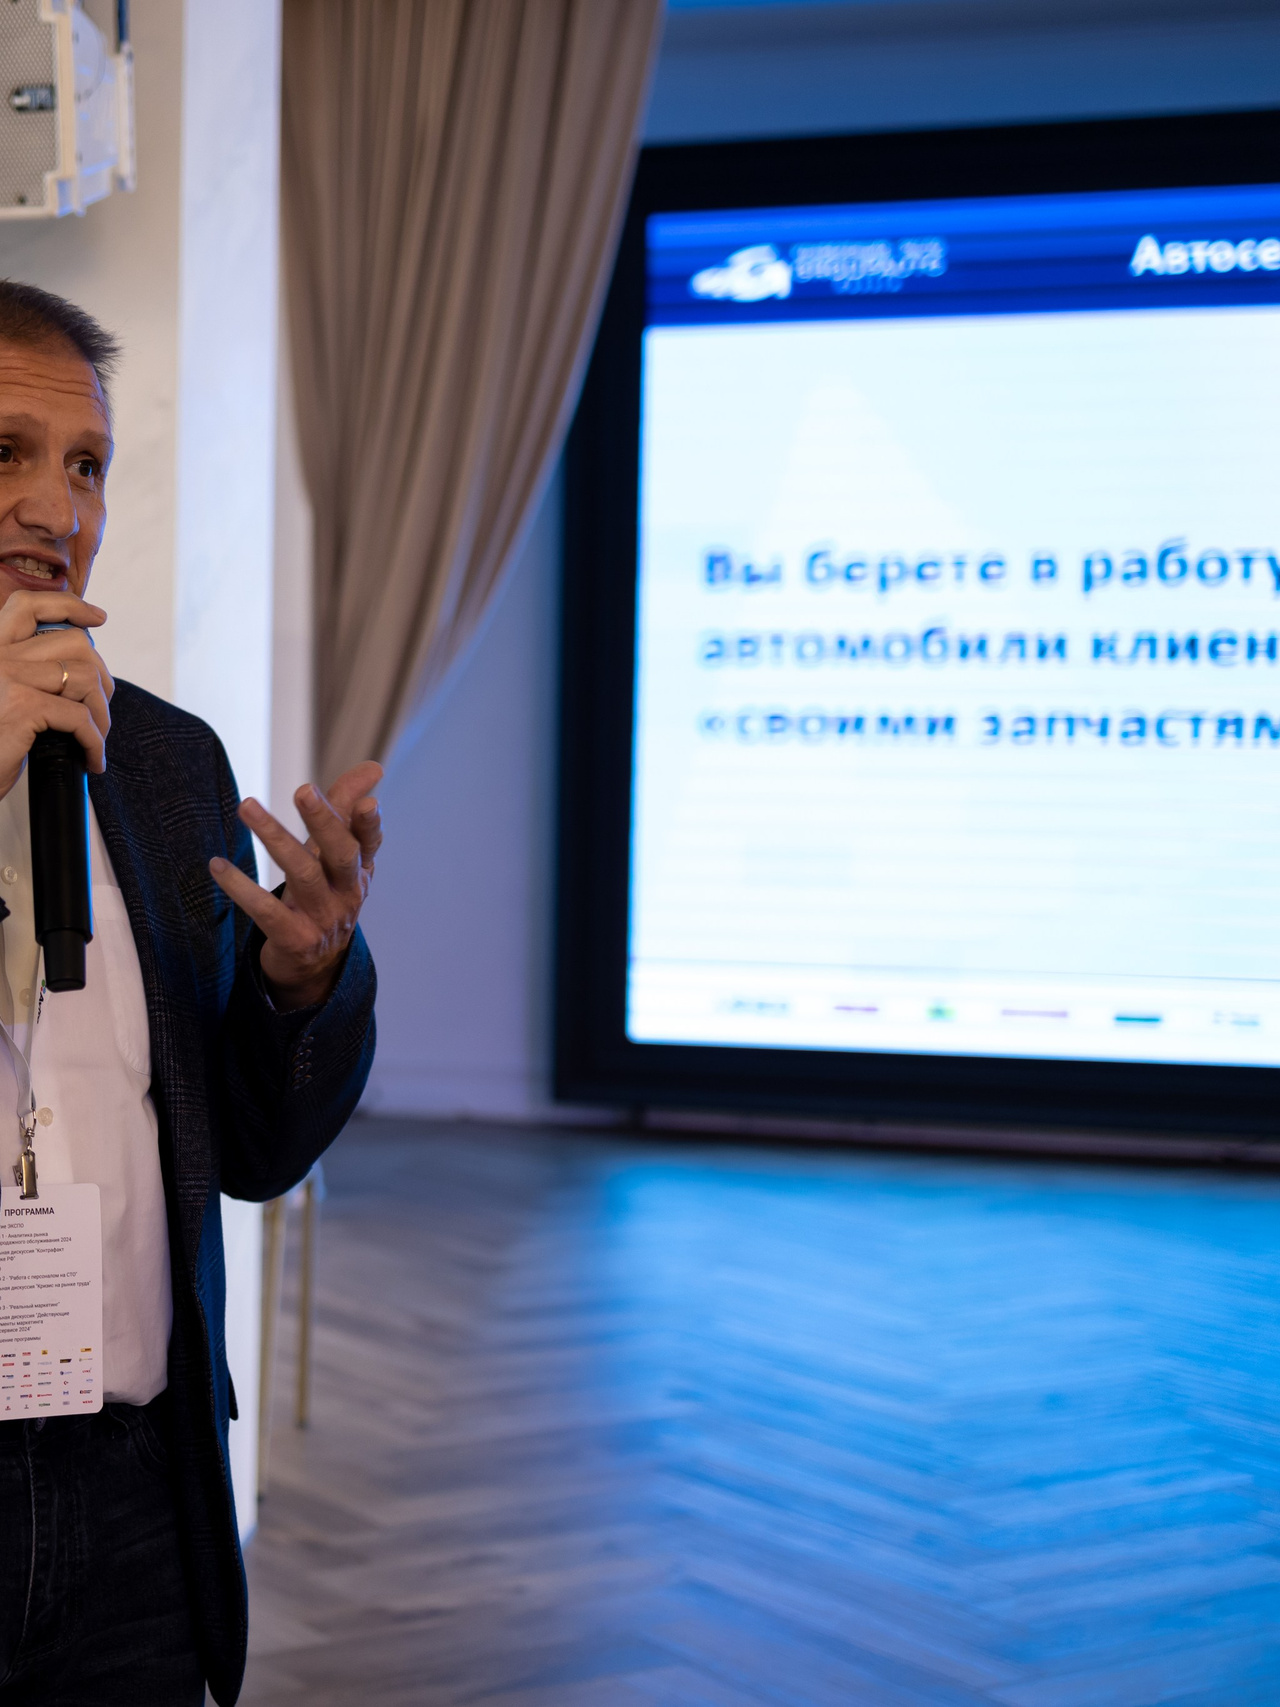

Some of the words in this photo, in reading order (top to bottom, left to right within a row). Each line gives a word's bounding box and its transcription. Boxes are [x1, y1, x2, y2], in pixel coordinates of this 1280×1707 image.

[1129, 233, 1280, 277] Автосе
[703, 546, 784, 588] Вы
[1031, 551, 1058, 587] в
[699, 618, 1069, 667] автомобили
[1091, 629, 1279, 668] клиен
[4, 1207, 54, 1216] ПРОГРАММА
